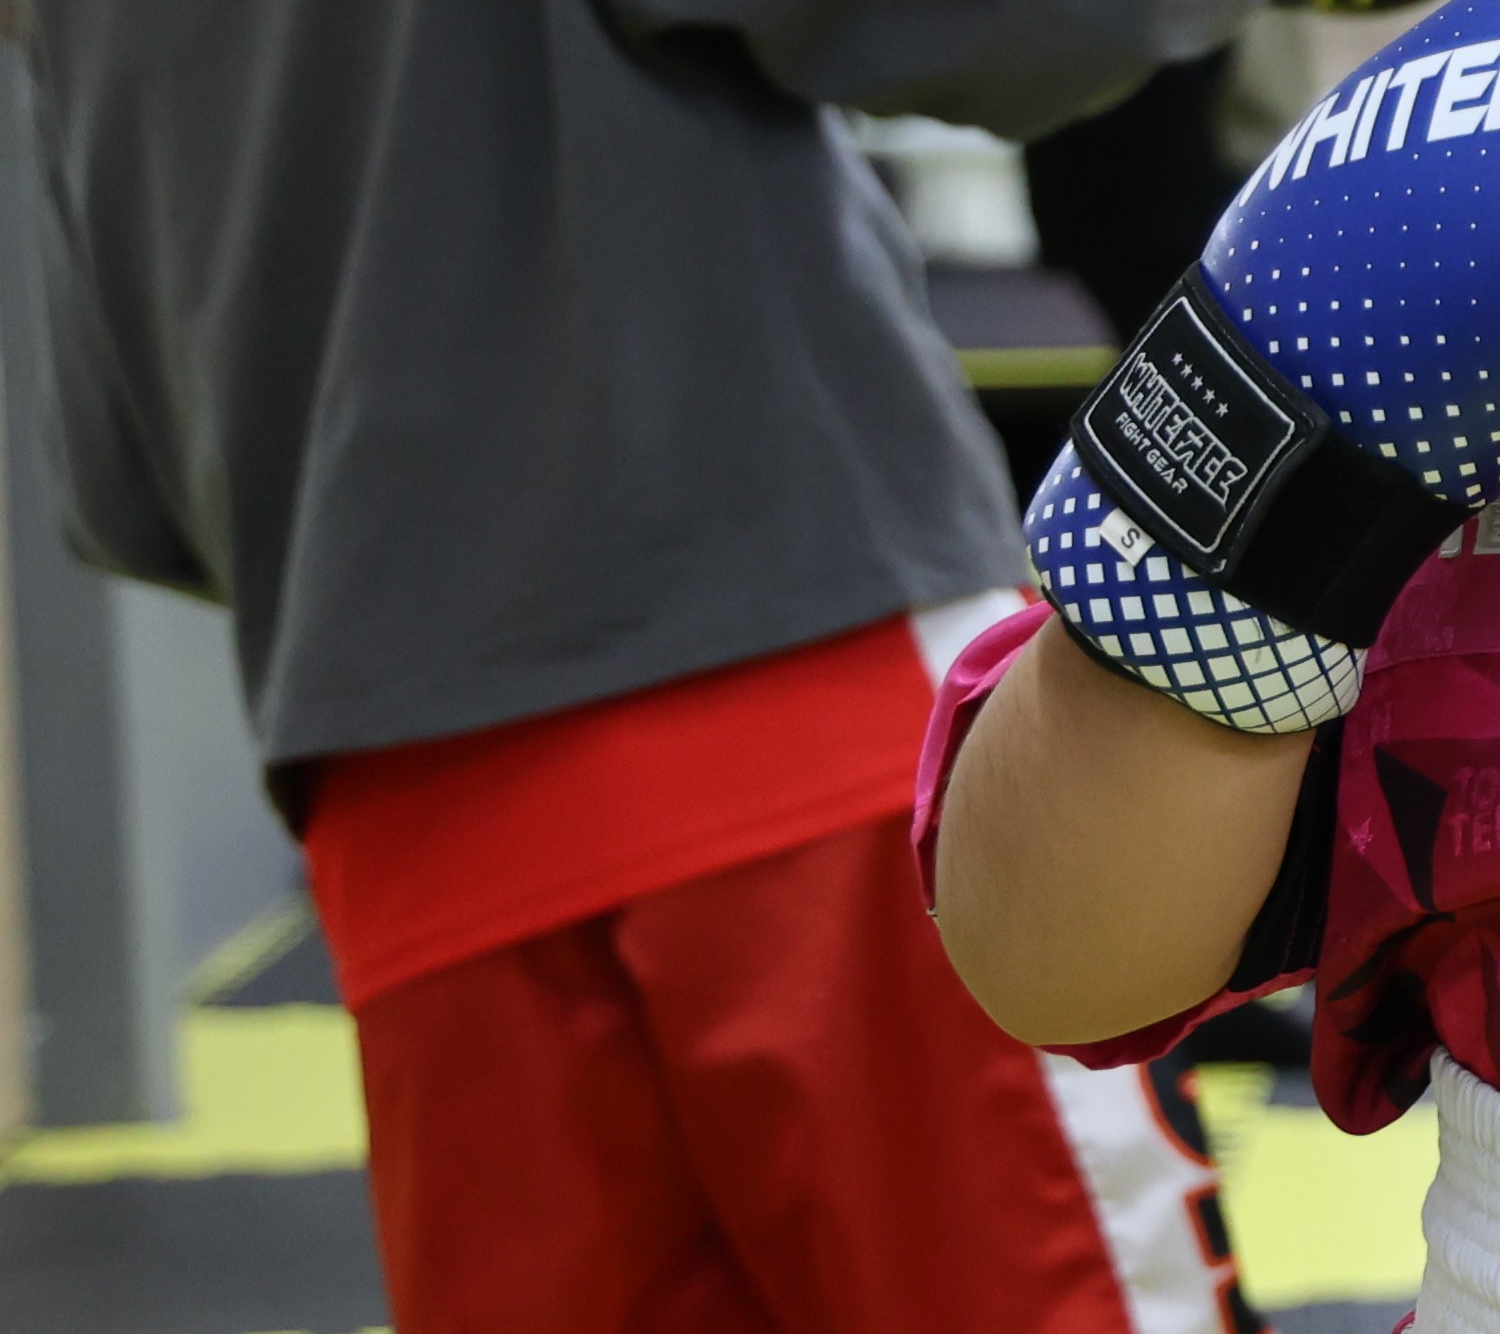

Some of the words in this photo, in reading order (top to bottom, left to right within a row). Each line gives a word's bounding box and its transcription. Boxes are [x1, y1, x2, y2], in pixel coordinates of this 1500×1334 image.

[1114, 412, 1150, 452] FIGHT
[1148, 448, 1189, 495] GEAR
[1120, 352, 1248, 512] WHITEFACE
[1120, 527, 1141, 550] S
